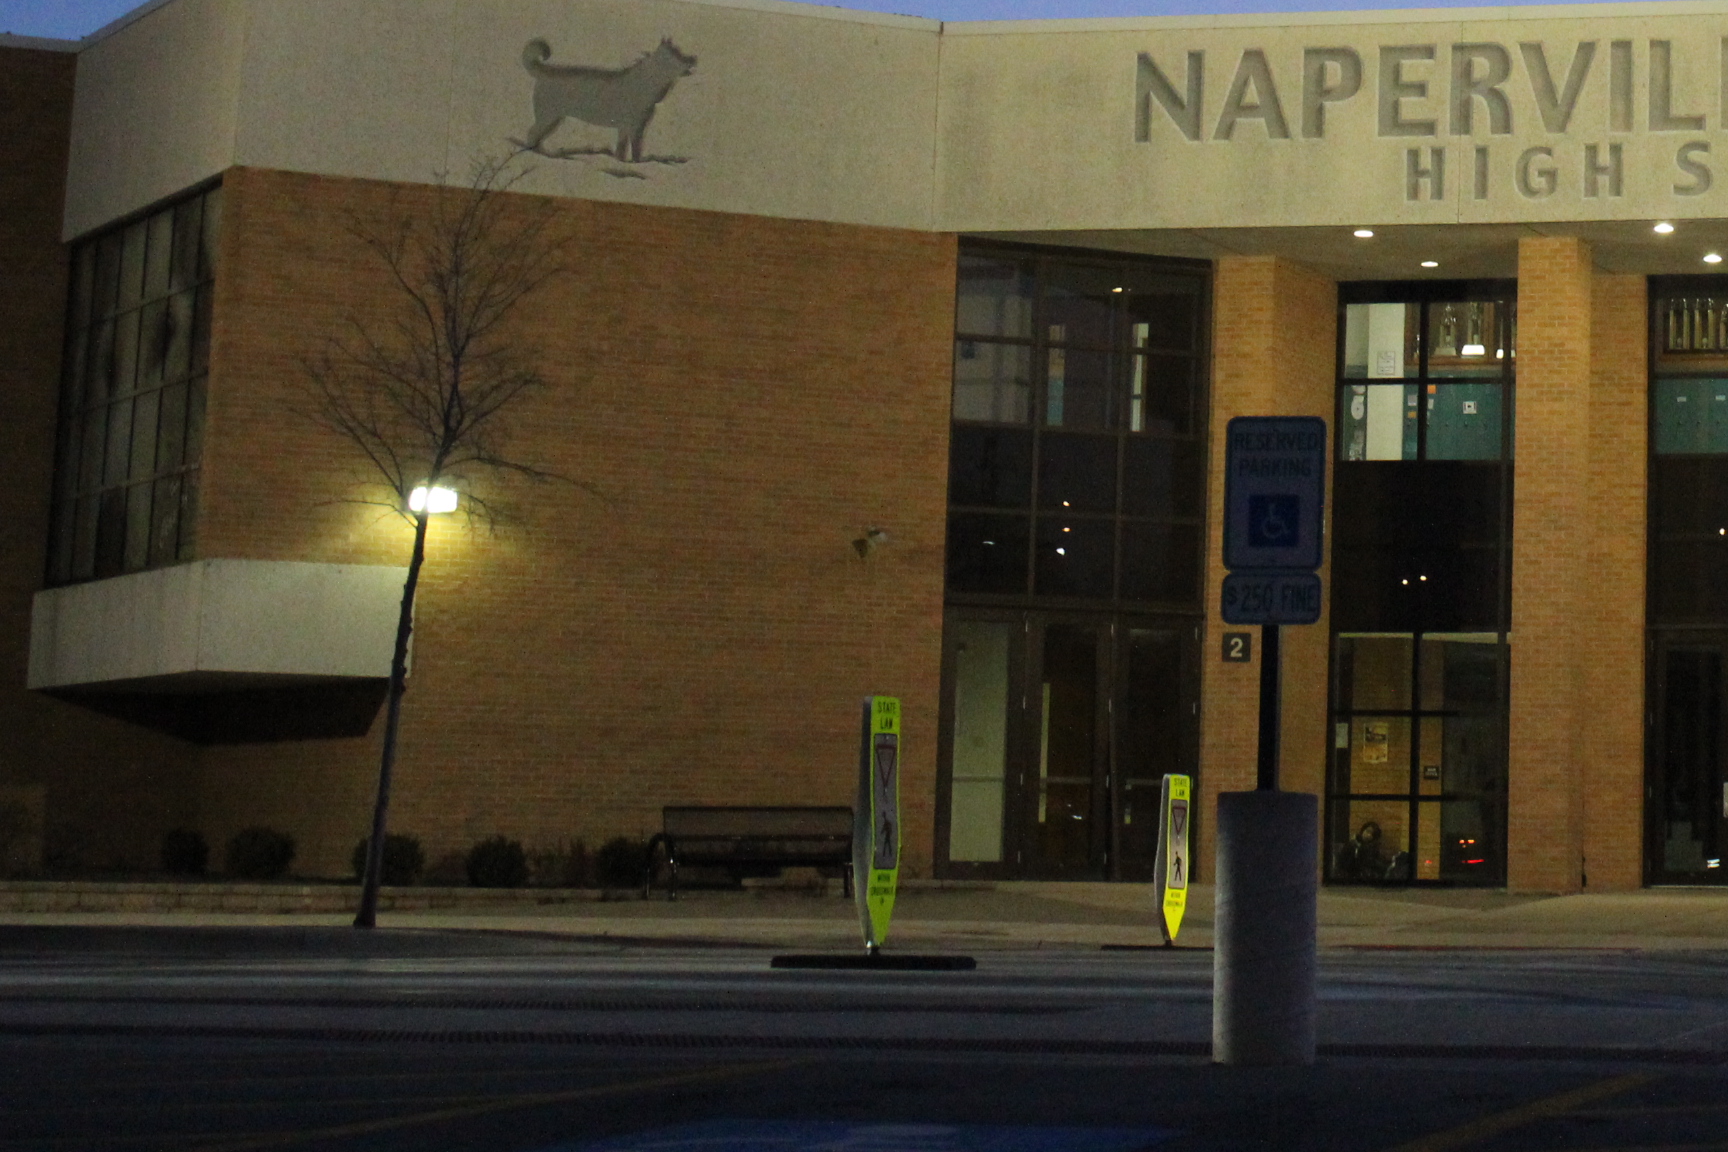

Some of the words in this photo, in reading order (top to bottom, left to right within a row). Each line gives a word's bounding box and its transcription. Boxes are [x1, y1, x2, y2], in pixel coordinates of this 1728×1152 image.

[1404, 143, 1624, 202] HIGH
[1234, 433, 1318, 450] RESERVED
[1239, 457, 1312, 478] PARKING
[1281, 583, 1318, 613] FINE
[1230, 637, 1244, 658] 2
[877, 701, 896, 714] STATE
[880, 716, 894, 730] LAW
